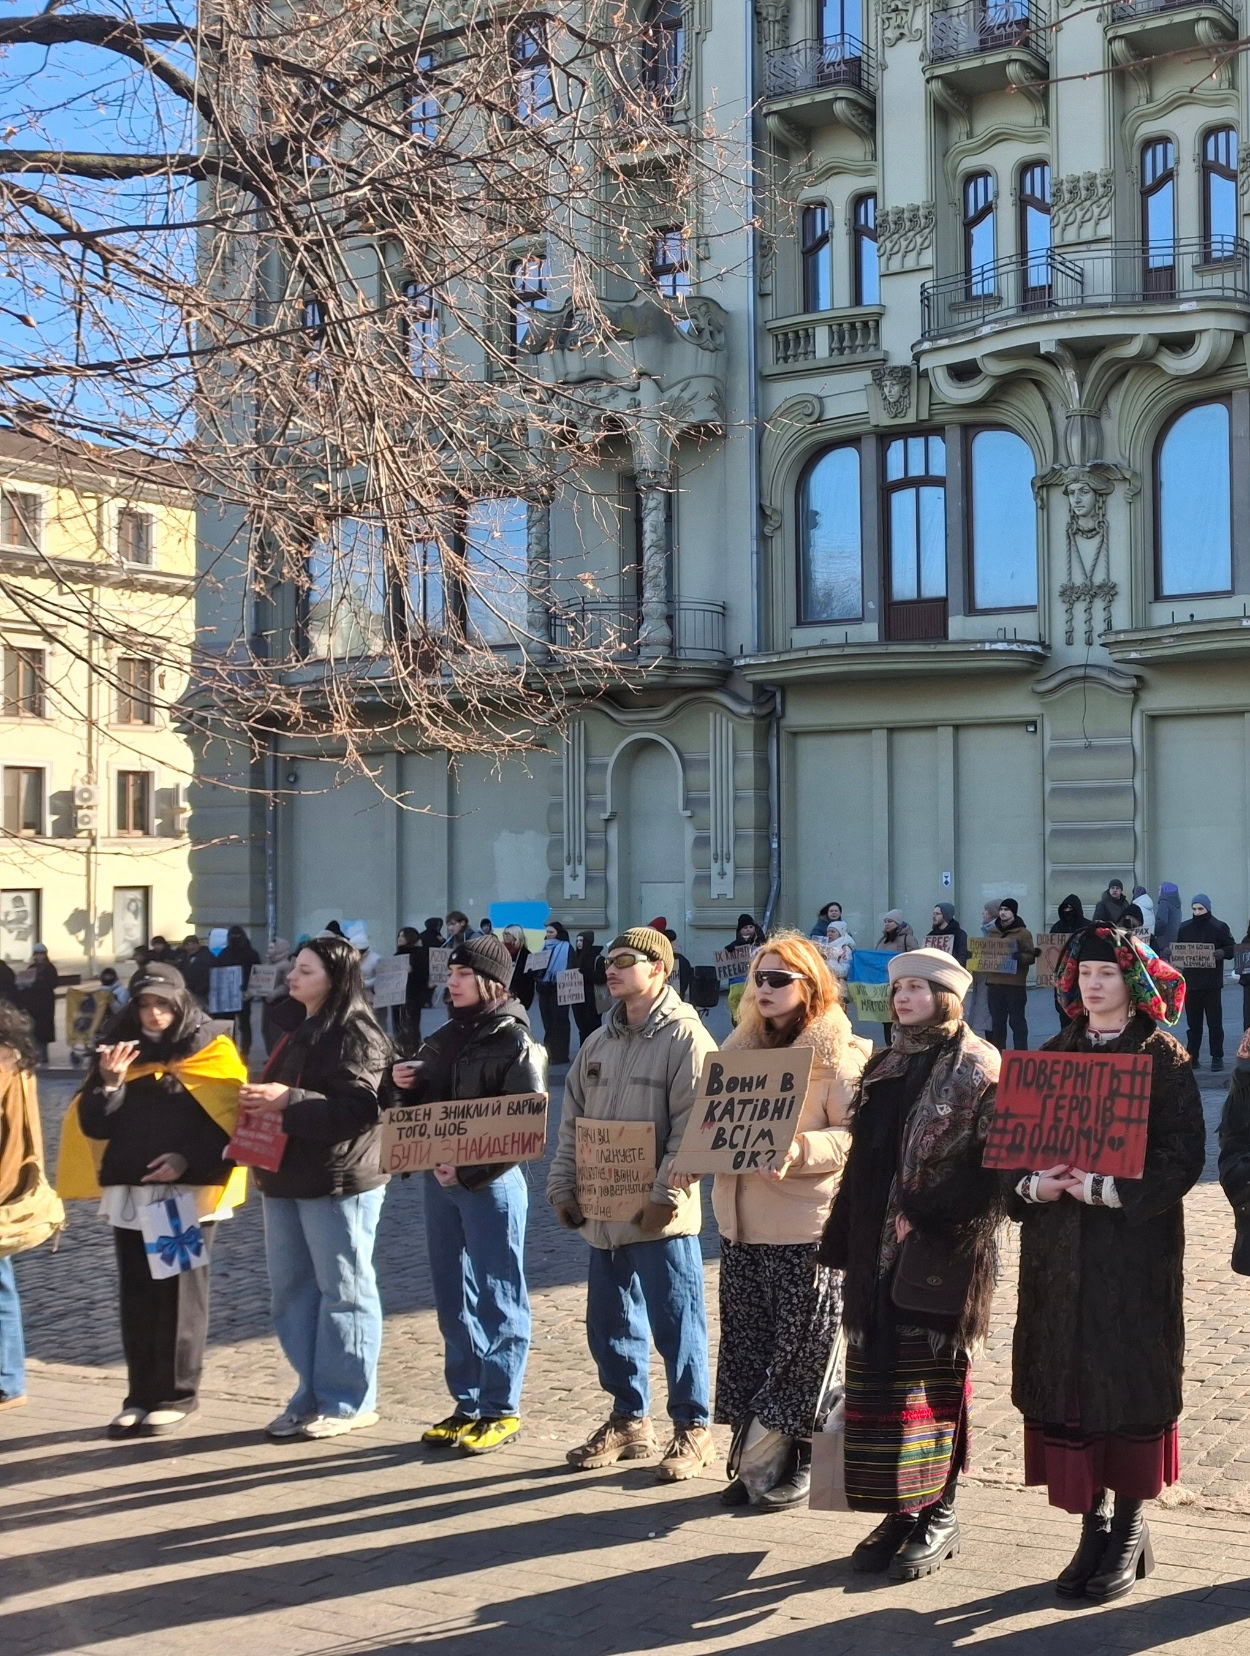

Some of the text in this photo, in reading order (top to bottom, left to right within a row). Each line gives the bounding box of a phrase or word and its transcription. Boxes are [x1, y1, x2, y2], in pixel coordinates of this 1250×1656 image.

[389, 1107, 432, 1125] КОЖЕН
[704, 1096, 796, 1123] КАТІВНІ
[397, 1121, 468, 1140] ТОГО, ЩОБ
[711, 1125, 775, 1150] ВСІМ
[1007, 1122, 1106, 1160] ДОДОМУ
[390, 1132, 545, 1171] БУТИ ЗНАЙДЕНИМ
[614, 1168, 640, 1183] ВОНИ
